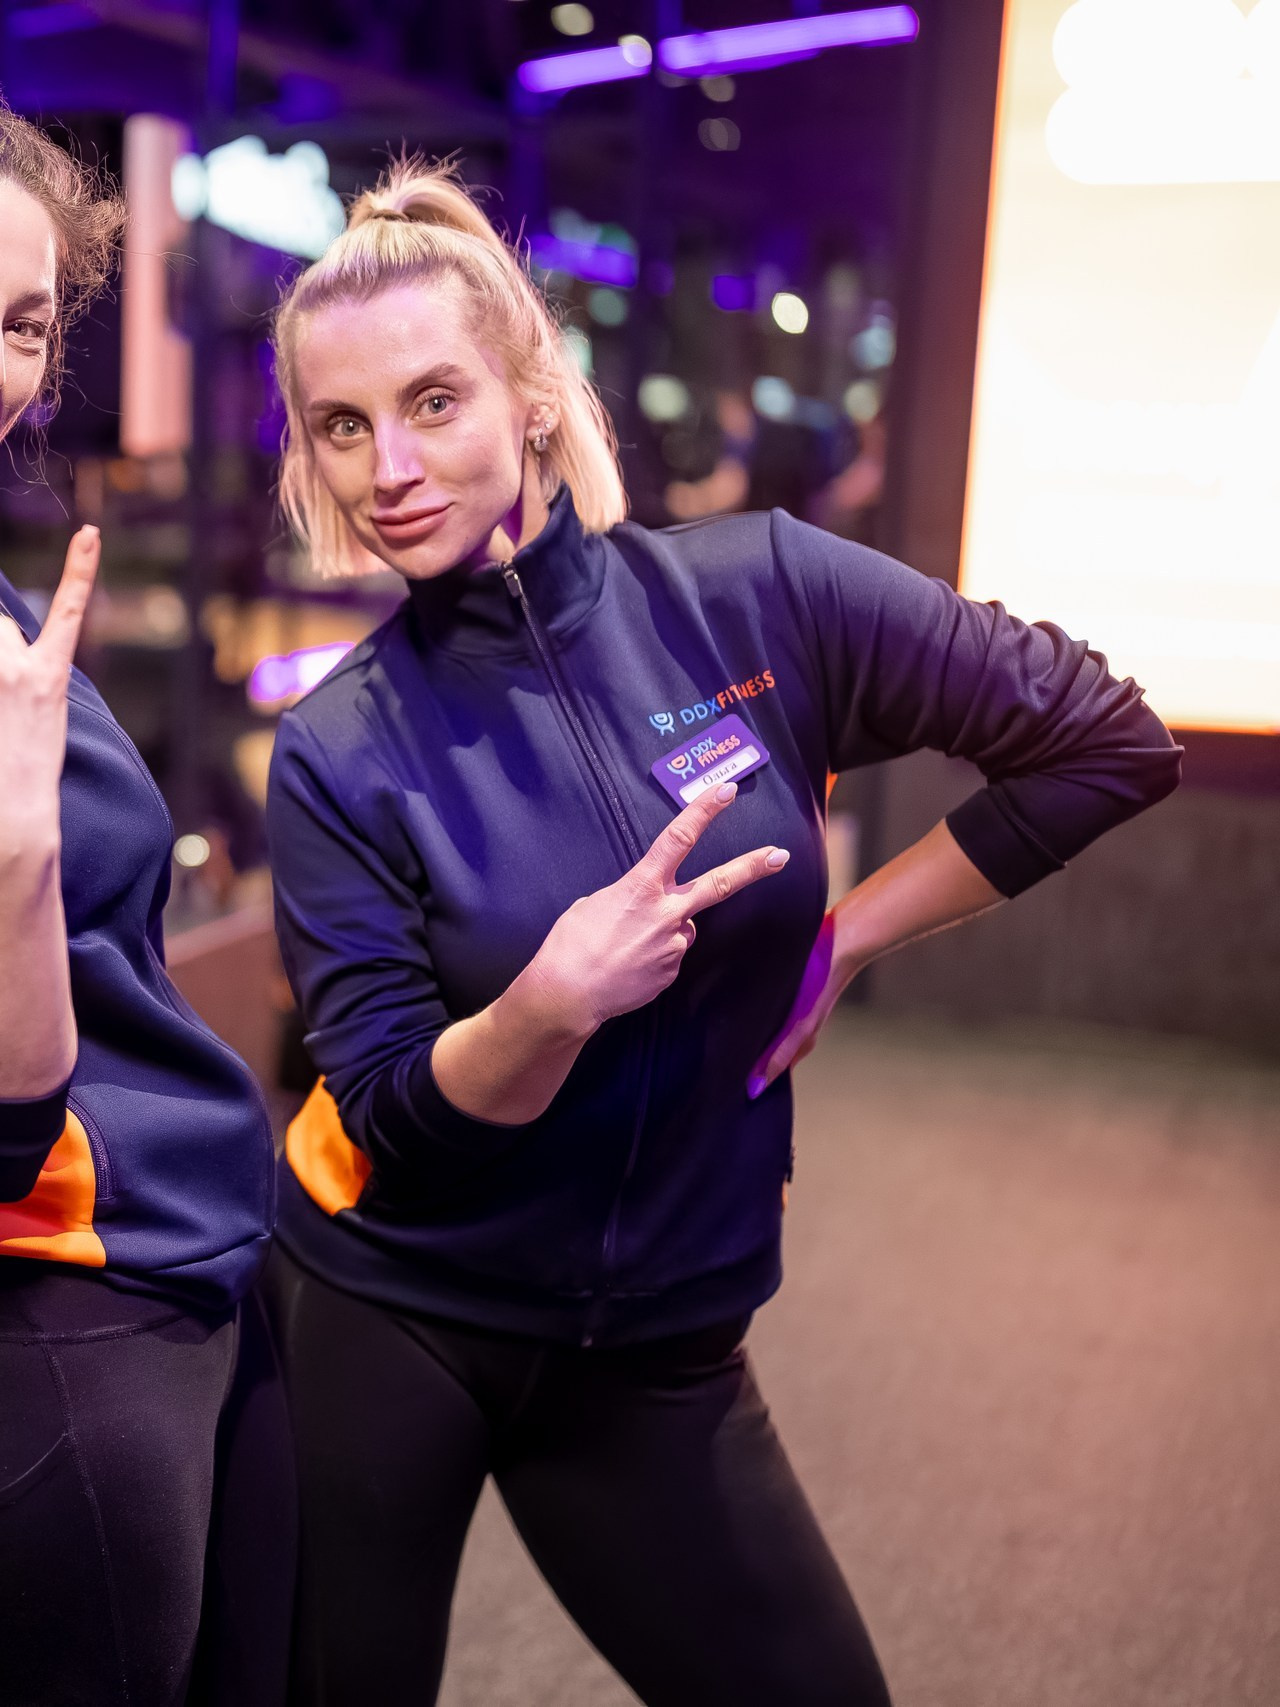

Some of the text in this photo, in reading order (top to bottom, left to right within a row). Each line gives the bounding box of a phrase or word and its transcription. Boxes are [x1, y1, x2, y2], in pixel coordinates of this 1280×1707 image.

[690, 736, 717, 759] DDX
[697, 734, 741, 767] FITNESS
[702, 762, 737, 785] Ольга
